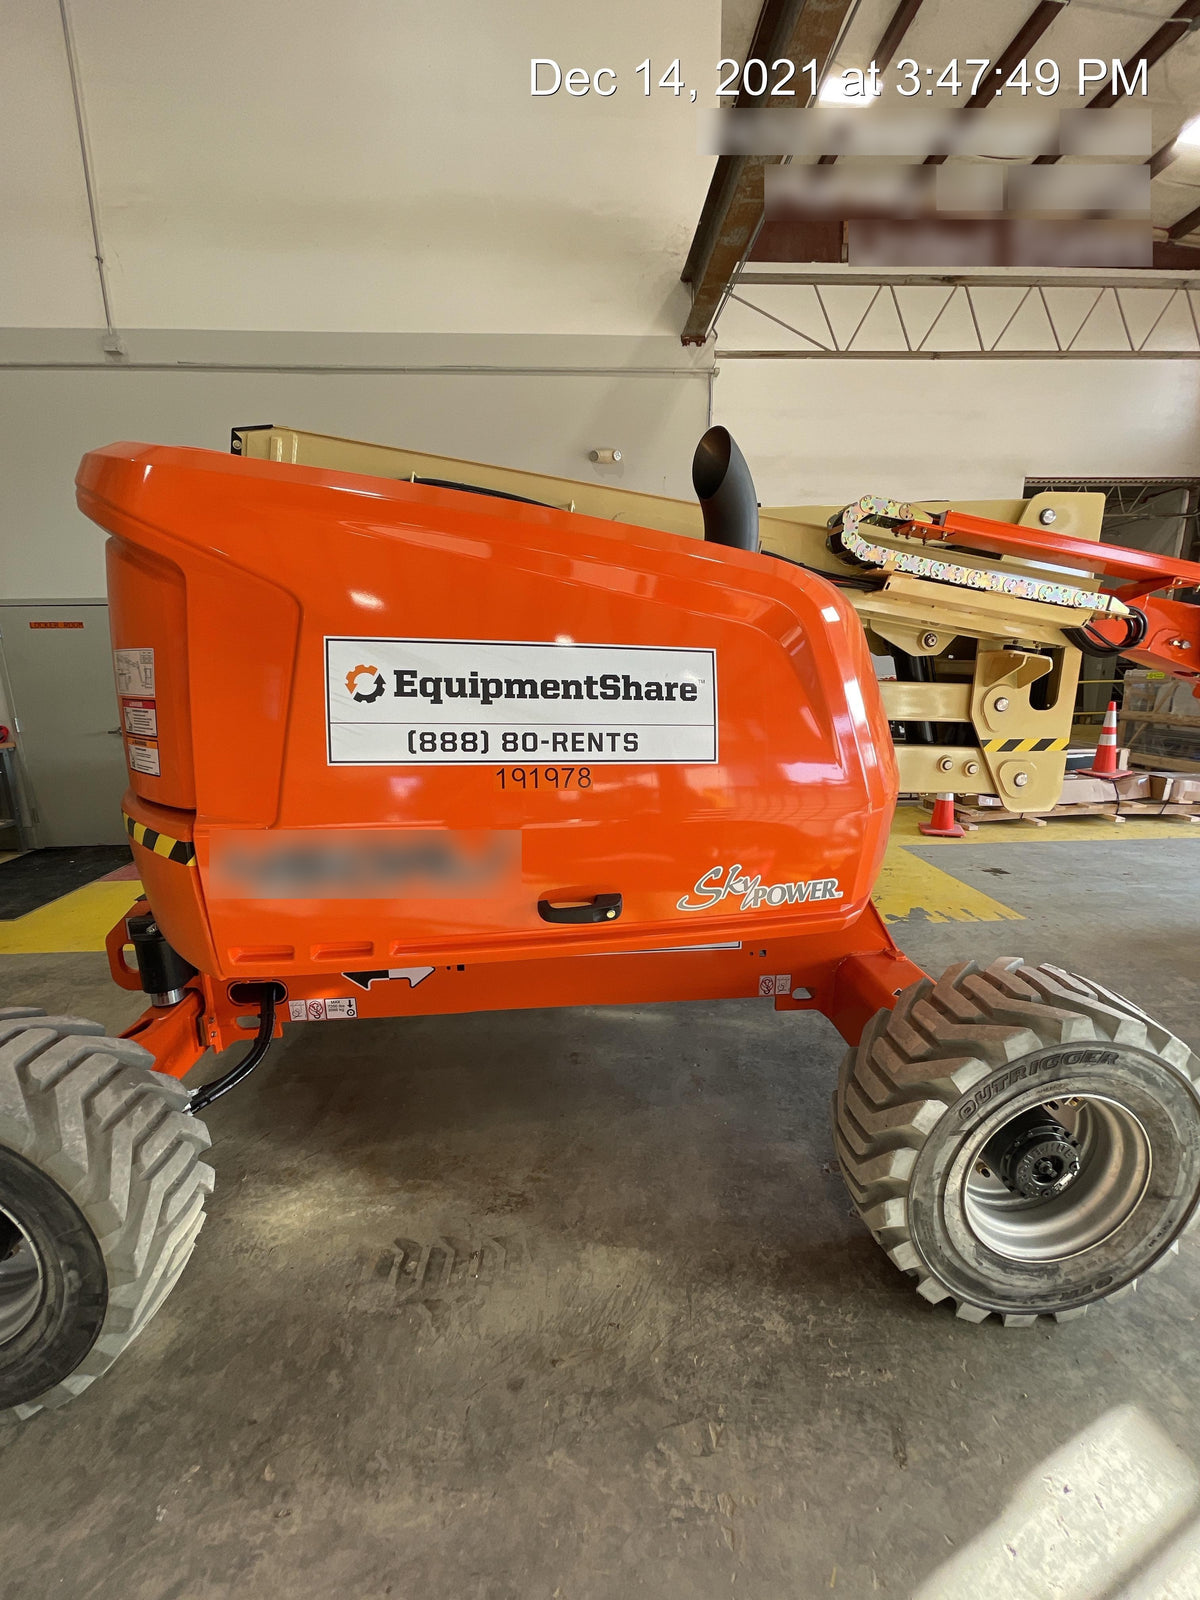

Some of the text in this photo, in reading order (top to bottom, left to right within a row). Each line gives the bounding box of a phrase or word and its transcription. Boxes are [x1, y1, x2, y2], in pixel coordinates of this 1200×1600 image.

[393, 669, 698, 705] EquipmentShare
[407, 729, 640, 755] (888) 80-RENTS
[496, 766, 592, 790] 191978
[958, 1049, 1120, 1121] OUTRIGGER
